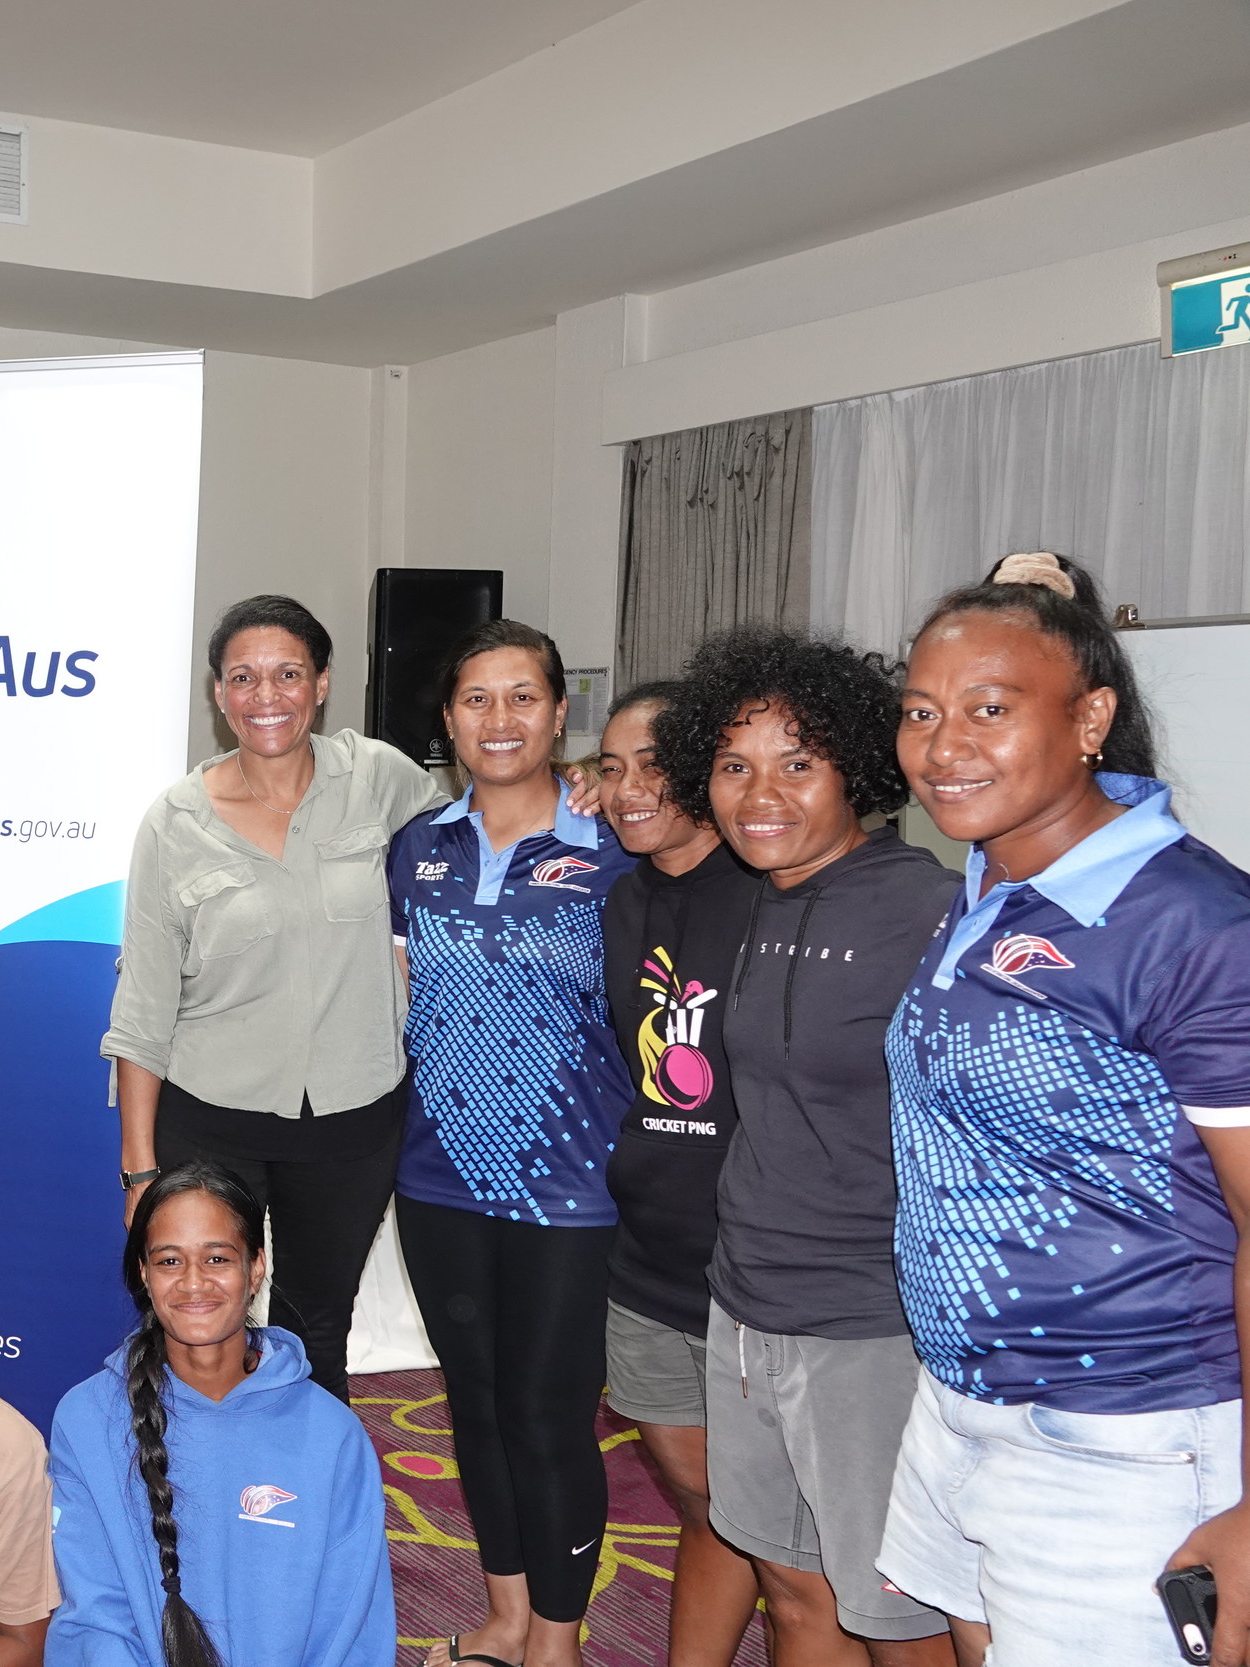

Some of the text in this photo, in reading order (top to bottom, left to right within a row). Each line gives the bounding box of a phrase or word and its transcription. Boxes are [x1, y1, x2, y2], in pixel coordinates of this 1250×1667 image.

[415, 873, 444, 881] SPORTS
[642, 1117, 717, 1136] CRICKET PNG
